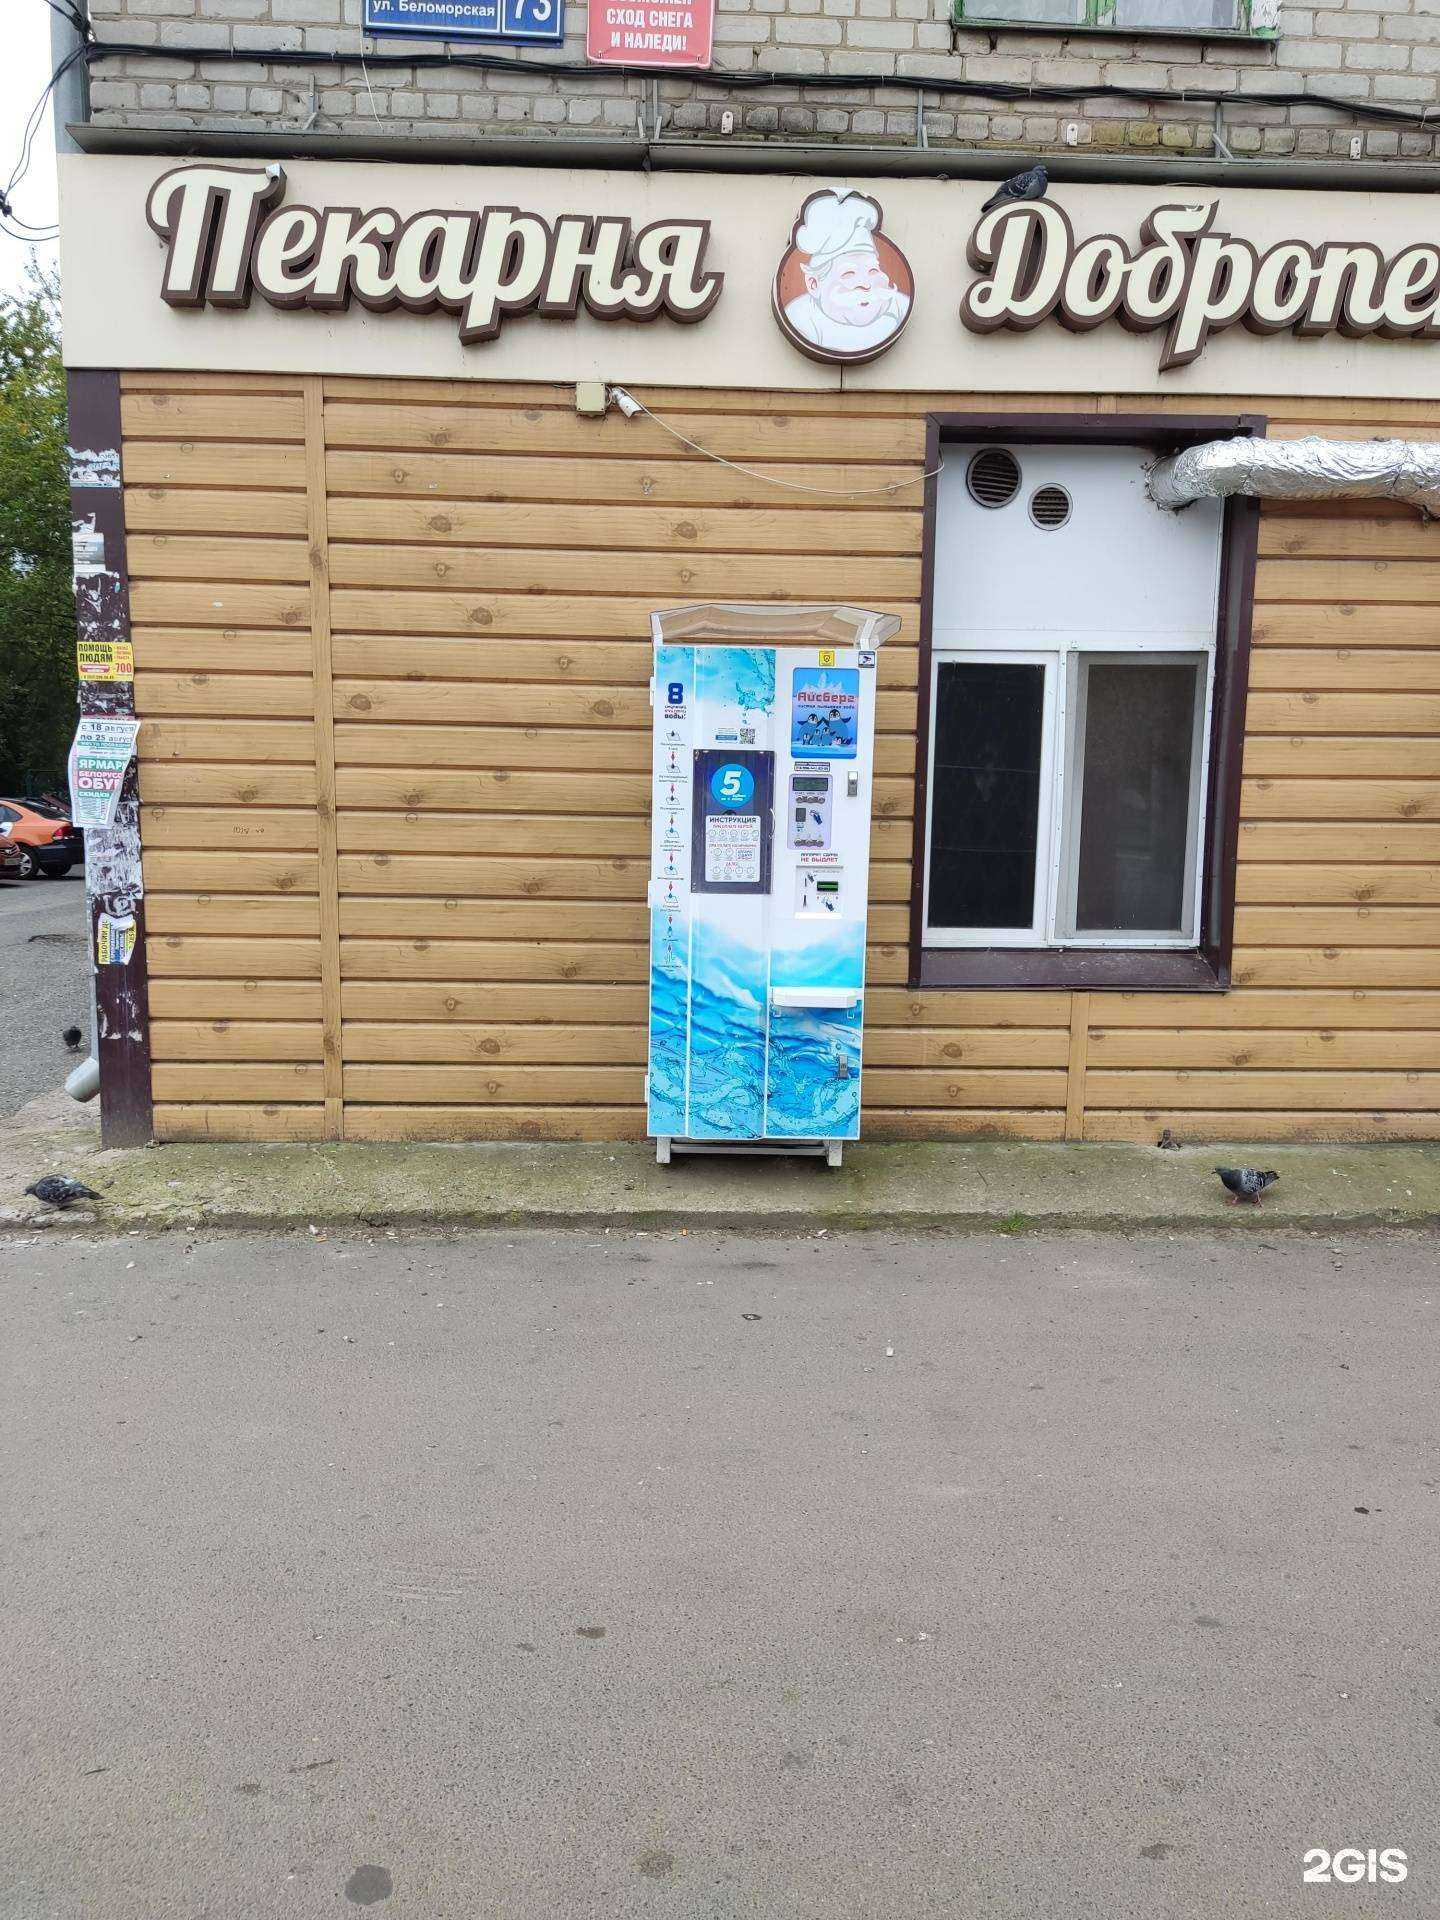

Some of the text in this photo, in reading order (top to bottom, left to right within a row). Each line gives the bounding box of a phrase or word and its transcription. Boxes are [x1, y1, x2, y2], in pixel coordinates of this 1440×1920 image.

[373, 0, 495, 17] ул. Беломорская
[514, 0, 552, 21] 73
[606, 8, 693, 28] СХОД СНЕГА
[610, 31, 687, 53] И НАЛЕДИ!
[145, 164, 724, 345] Пекарня
[960, 200, 1440, 374] Добропе
[79, 643, 113, 653] ПОМОЩЬ
[80, 653, 113, 663] ЛЮДЯМ
[668, 683, 684, 704] 8
[797, 691, 856, 704] Айсберг
[720, 770, 742, 796] 5
[709, 816, 757, 824] ИНСТРУКЦИЯ
